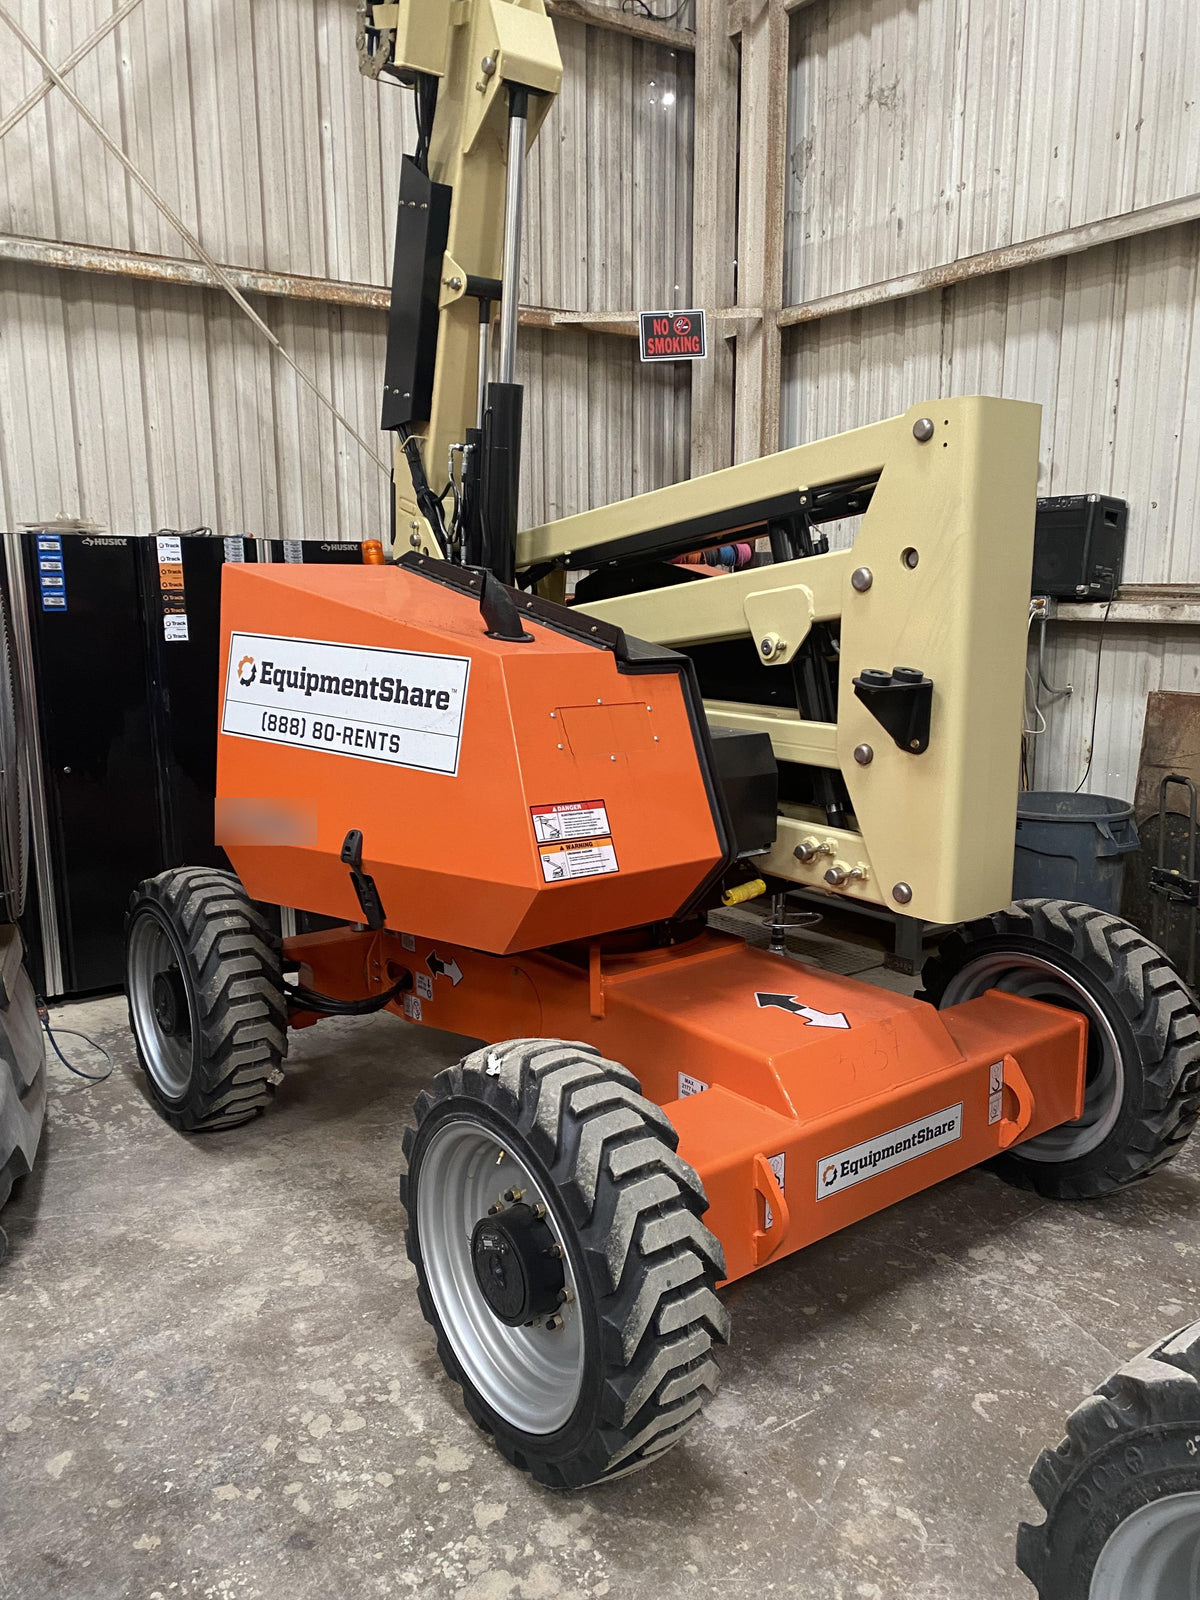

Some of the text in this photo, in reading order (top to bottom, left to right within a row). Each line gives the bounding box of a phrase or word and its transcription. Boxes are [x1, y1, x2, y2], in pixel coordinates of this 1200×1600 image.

[653, 318, 669, 335] NO
[647, 335, 700, 354] SMOKING
[94, 538, 127, 546] HUSKY
[331, 543, 358, 551] HUSKY
[259, 660, 450, 711] EquipmentShare
[262, 712, 400, 753] (888) 80-RENTS
[566, 841, 593, 850] WARNING
[840, 1119, 955, 1178] EquipmentShare
